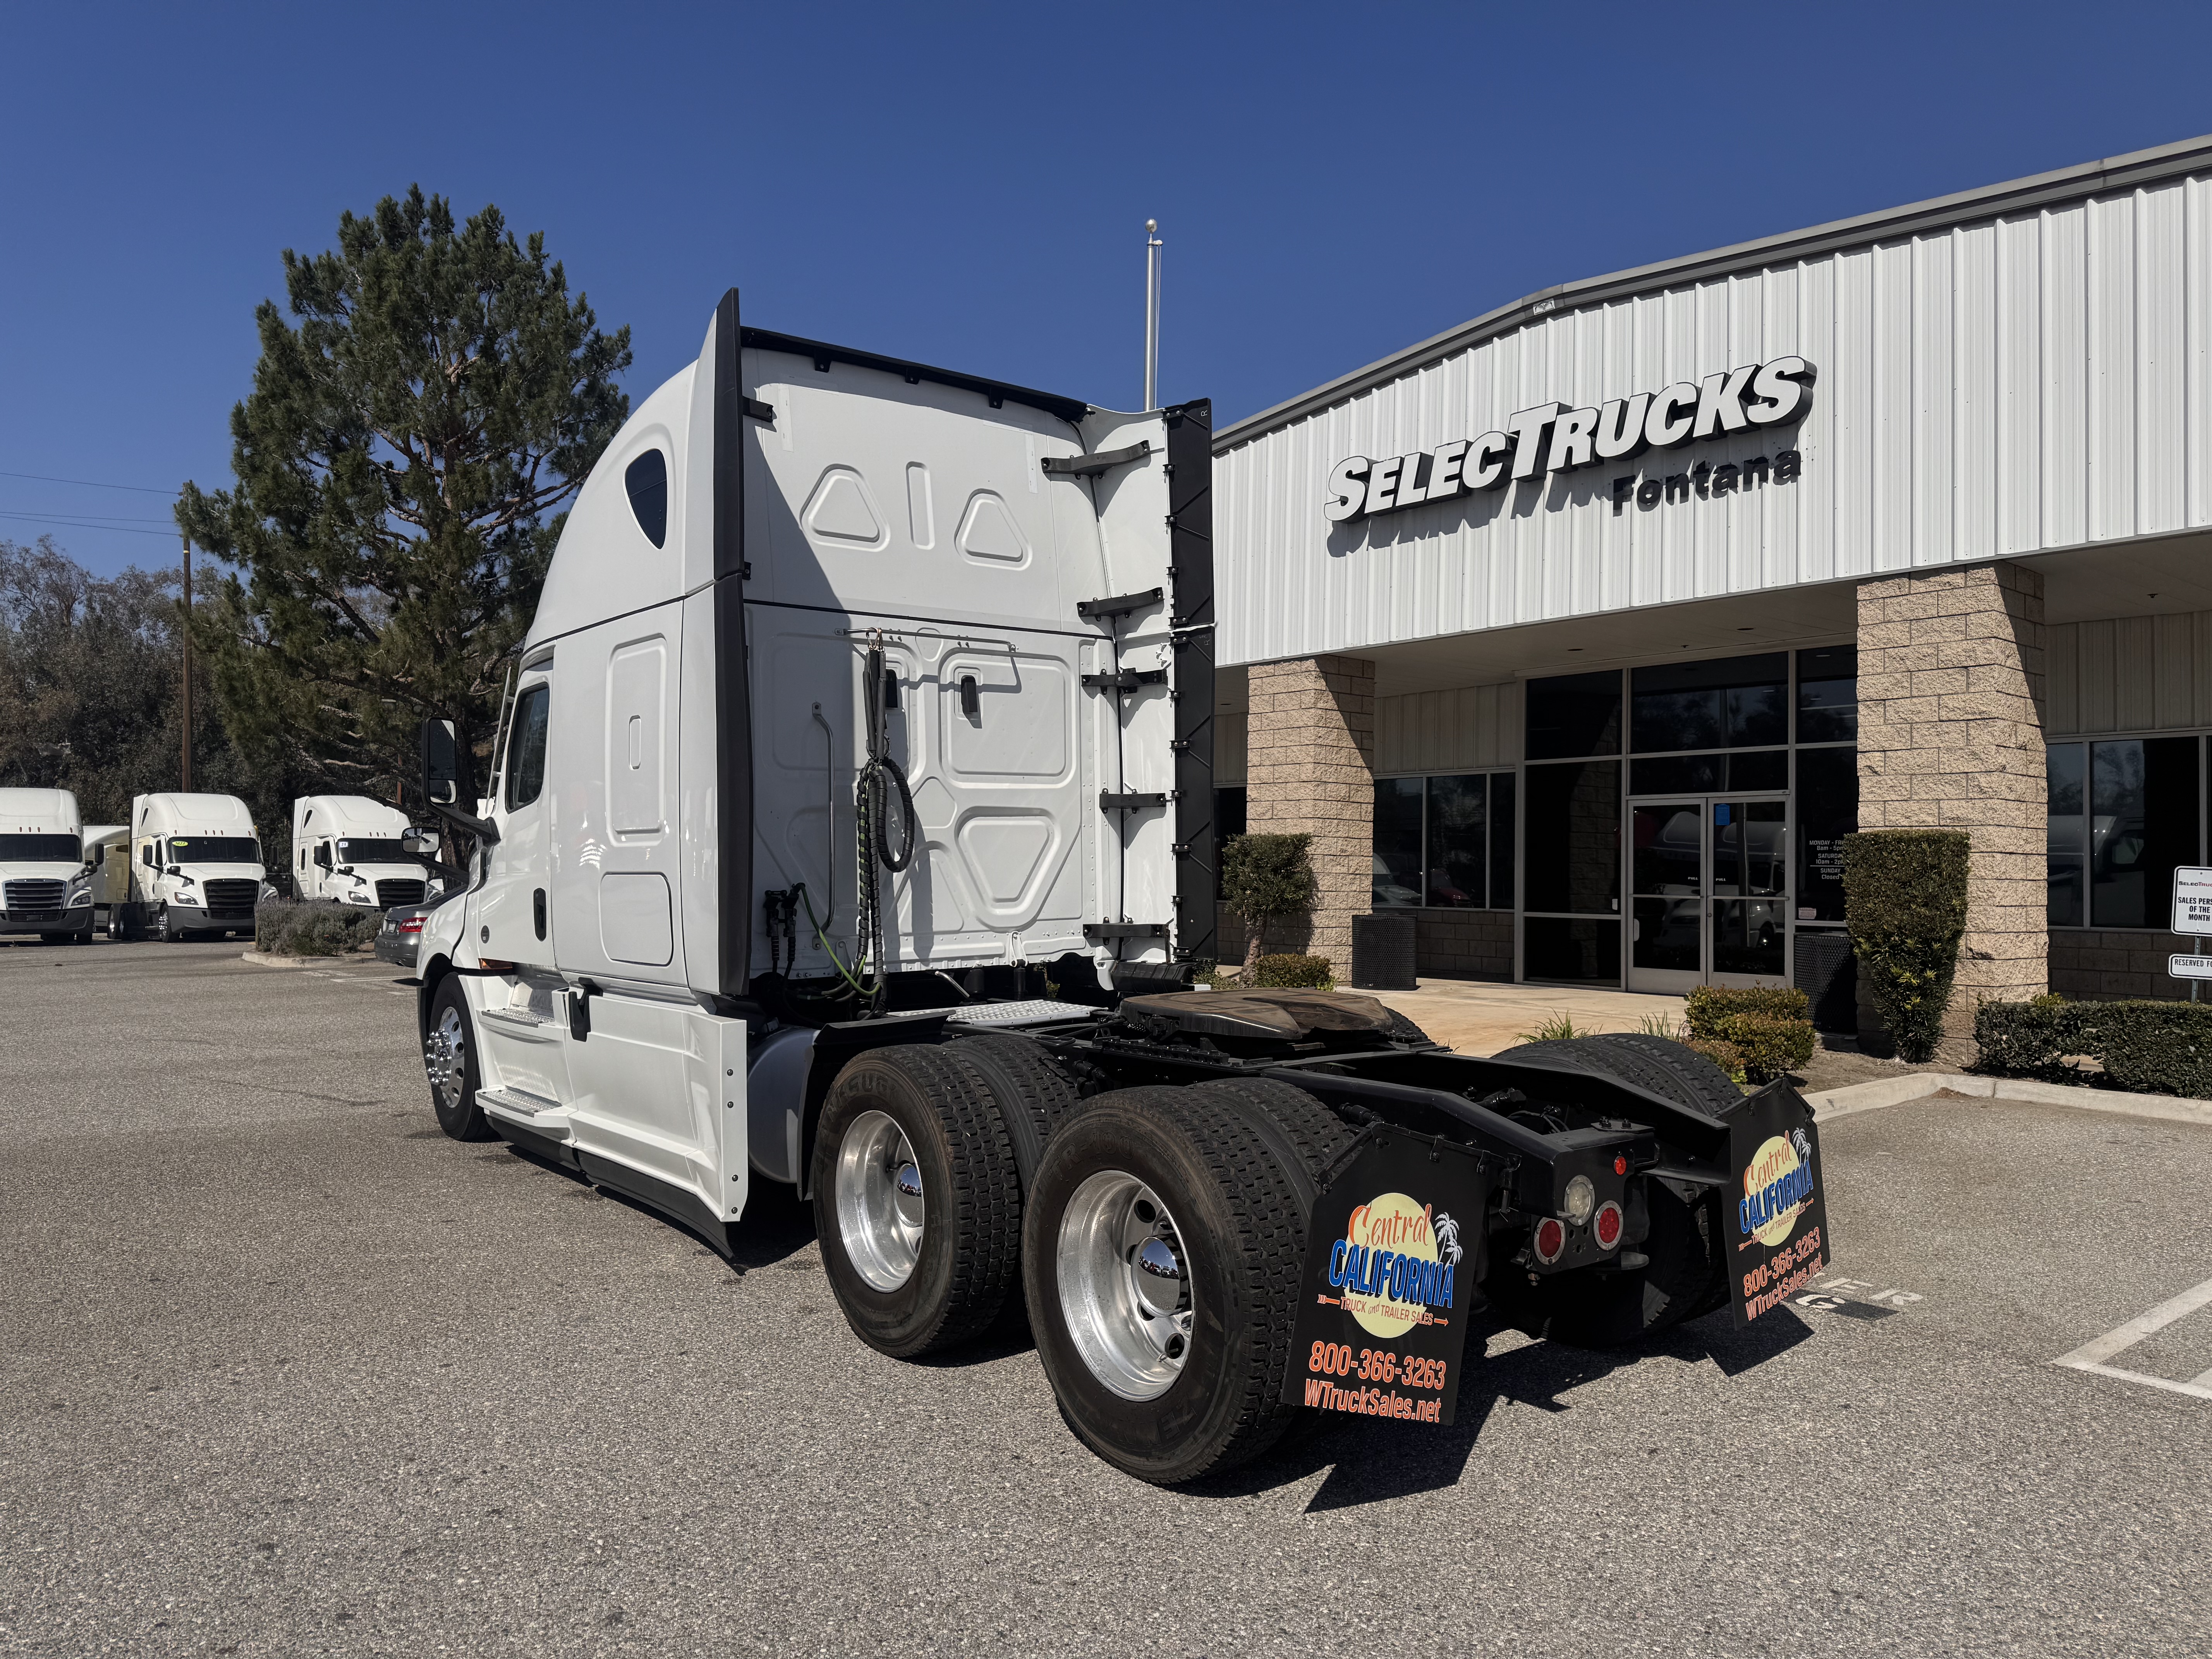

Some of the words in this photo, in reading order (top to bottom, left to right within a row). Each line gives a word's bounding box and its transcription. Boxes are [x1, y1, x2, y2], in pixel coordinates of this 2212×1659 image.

[1613, 448, 1801, 510] Fontana
[1744, 1130, 1792, 1197] Central
[1348, 1203, 1432, 1249] Central
[1739, 1160, 1814, 1234] CALIFORNIA
[1752, 1227, 1768, 1245] TRUCK
[1775, 1211, 1792, 1231] TRAILER
[1793, 1203, 1806, 1219] SALES
[1329, 1239, 1453, 1309] CALIFORNIA
[1744, 1226, 1821, 1297] 800-366-3263
[1746, 1252, 1823, 1321] WTruckSales.net
[1340, 1296, 1366, 1314] TRUCK
[1368, 1300, 1380, 1315] and
[1381, 1304, 1410, 1322] TRAILER
[1411, 1310, 1434, 1326] SALES
[1309, 1341, 1446, 1390] 800-366-3263
[1304, 1378, 1441, 1423] WTruckSales.net
